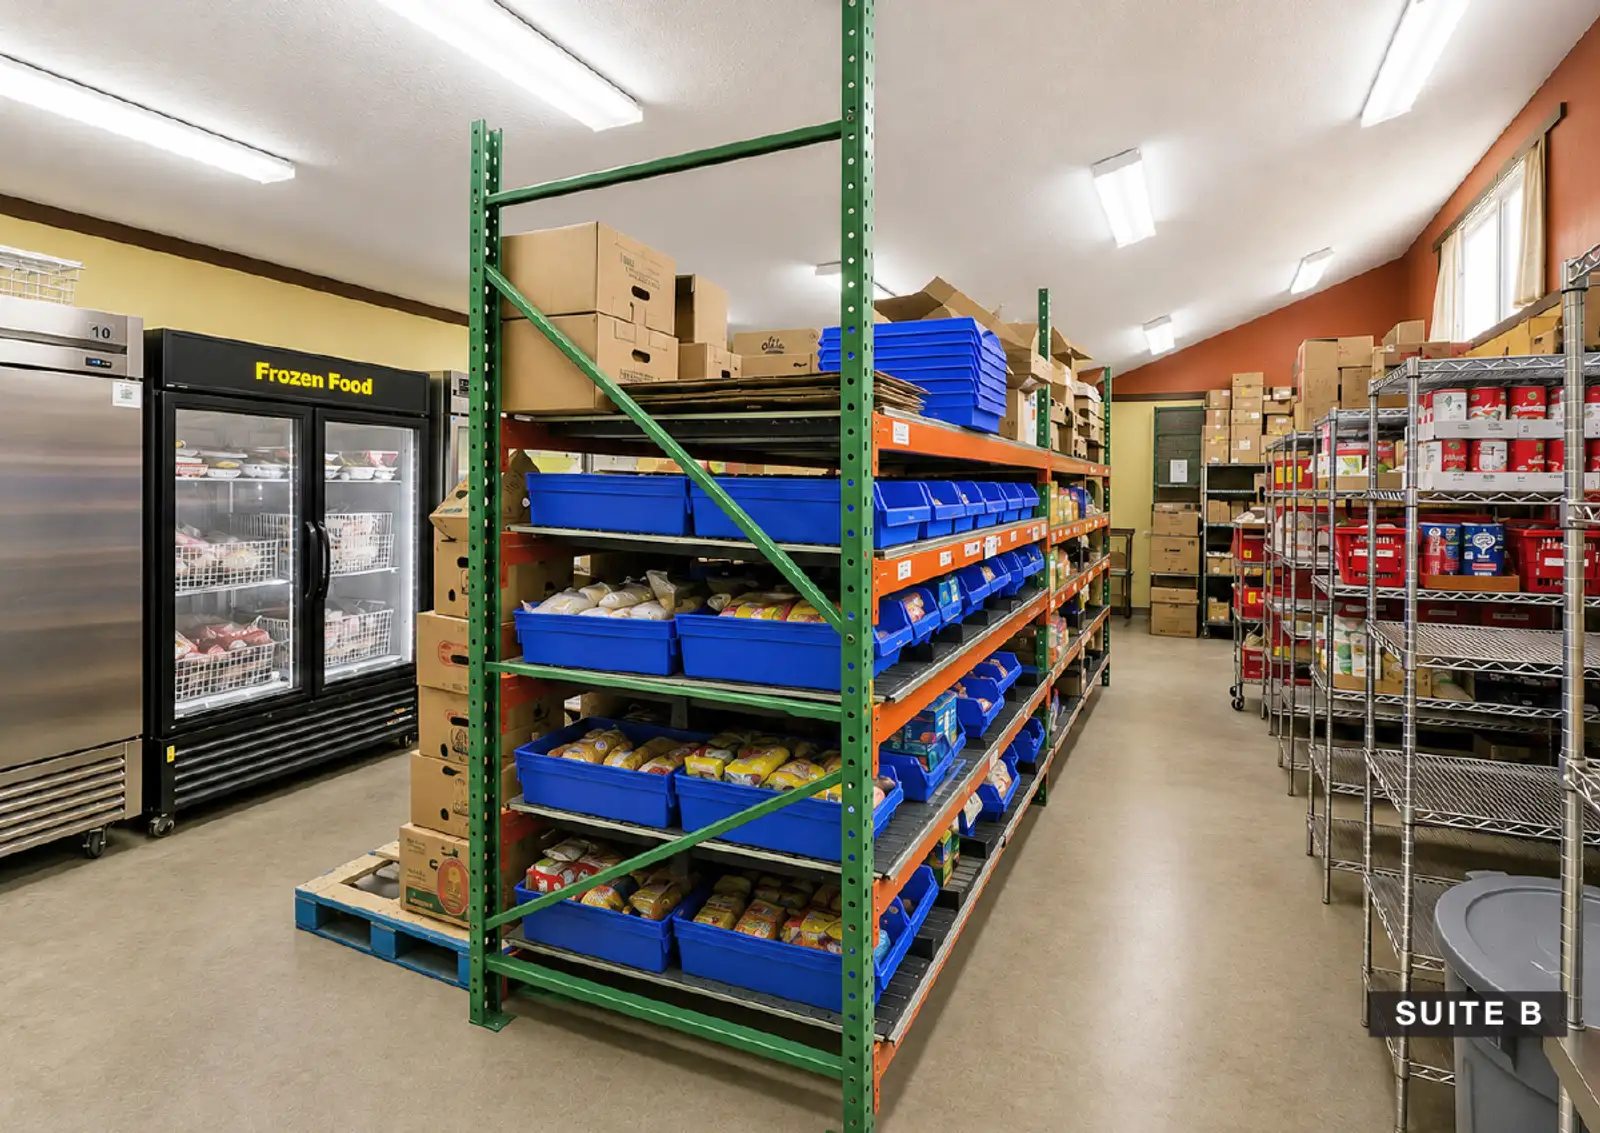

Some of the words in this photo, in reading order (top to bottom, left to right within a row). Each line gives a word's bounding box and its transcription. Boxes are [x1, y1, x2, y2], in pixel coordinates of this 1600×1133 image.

[92, 326, 111, 339] 10
[256, 361, 324, 388] Frozen
[328, 372, 373, 395] Food
